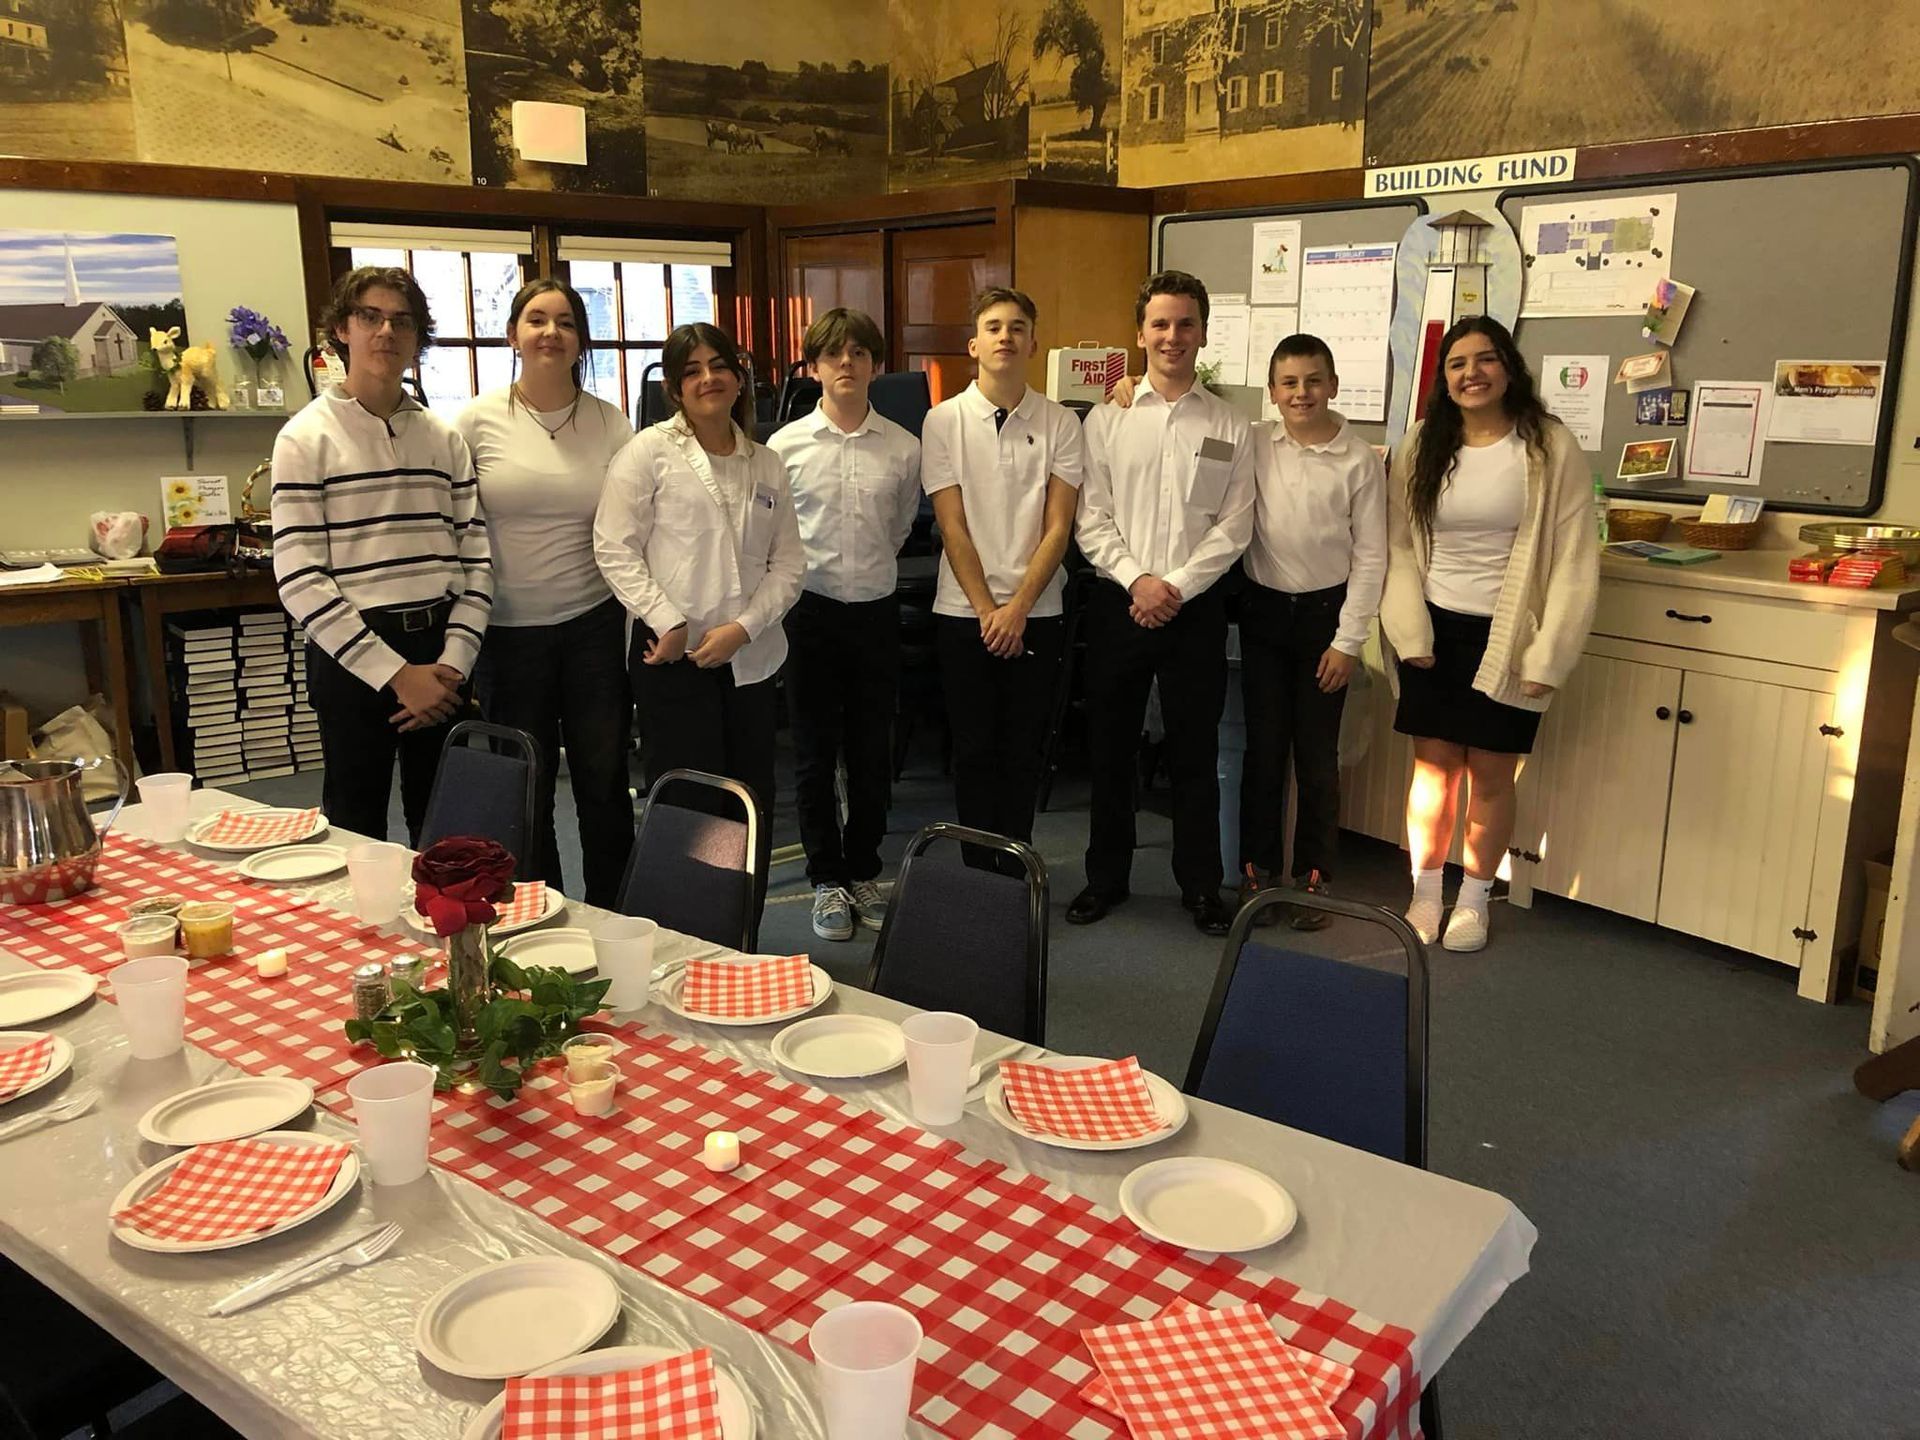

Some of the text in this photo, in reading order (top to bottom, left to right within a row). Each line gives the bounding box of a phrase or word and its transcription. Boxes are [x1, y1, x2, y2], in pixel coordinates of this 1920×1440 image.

[1375, 155, 1569, 193] BUILDING FUND
[477, 177, 487, 185] 10
[1083, 372, 1105, 385] AID
[1815, 386, 1838, 396] Prayer
[1840, 387, 1875, 396] Breakfast
